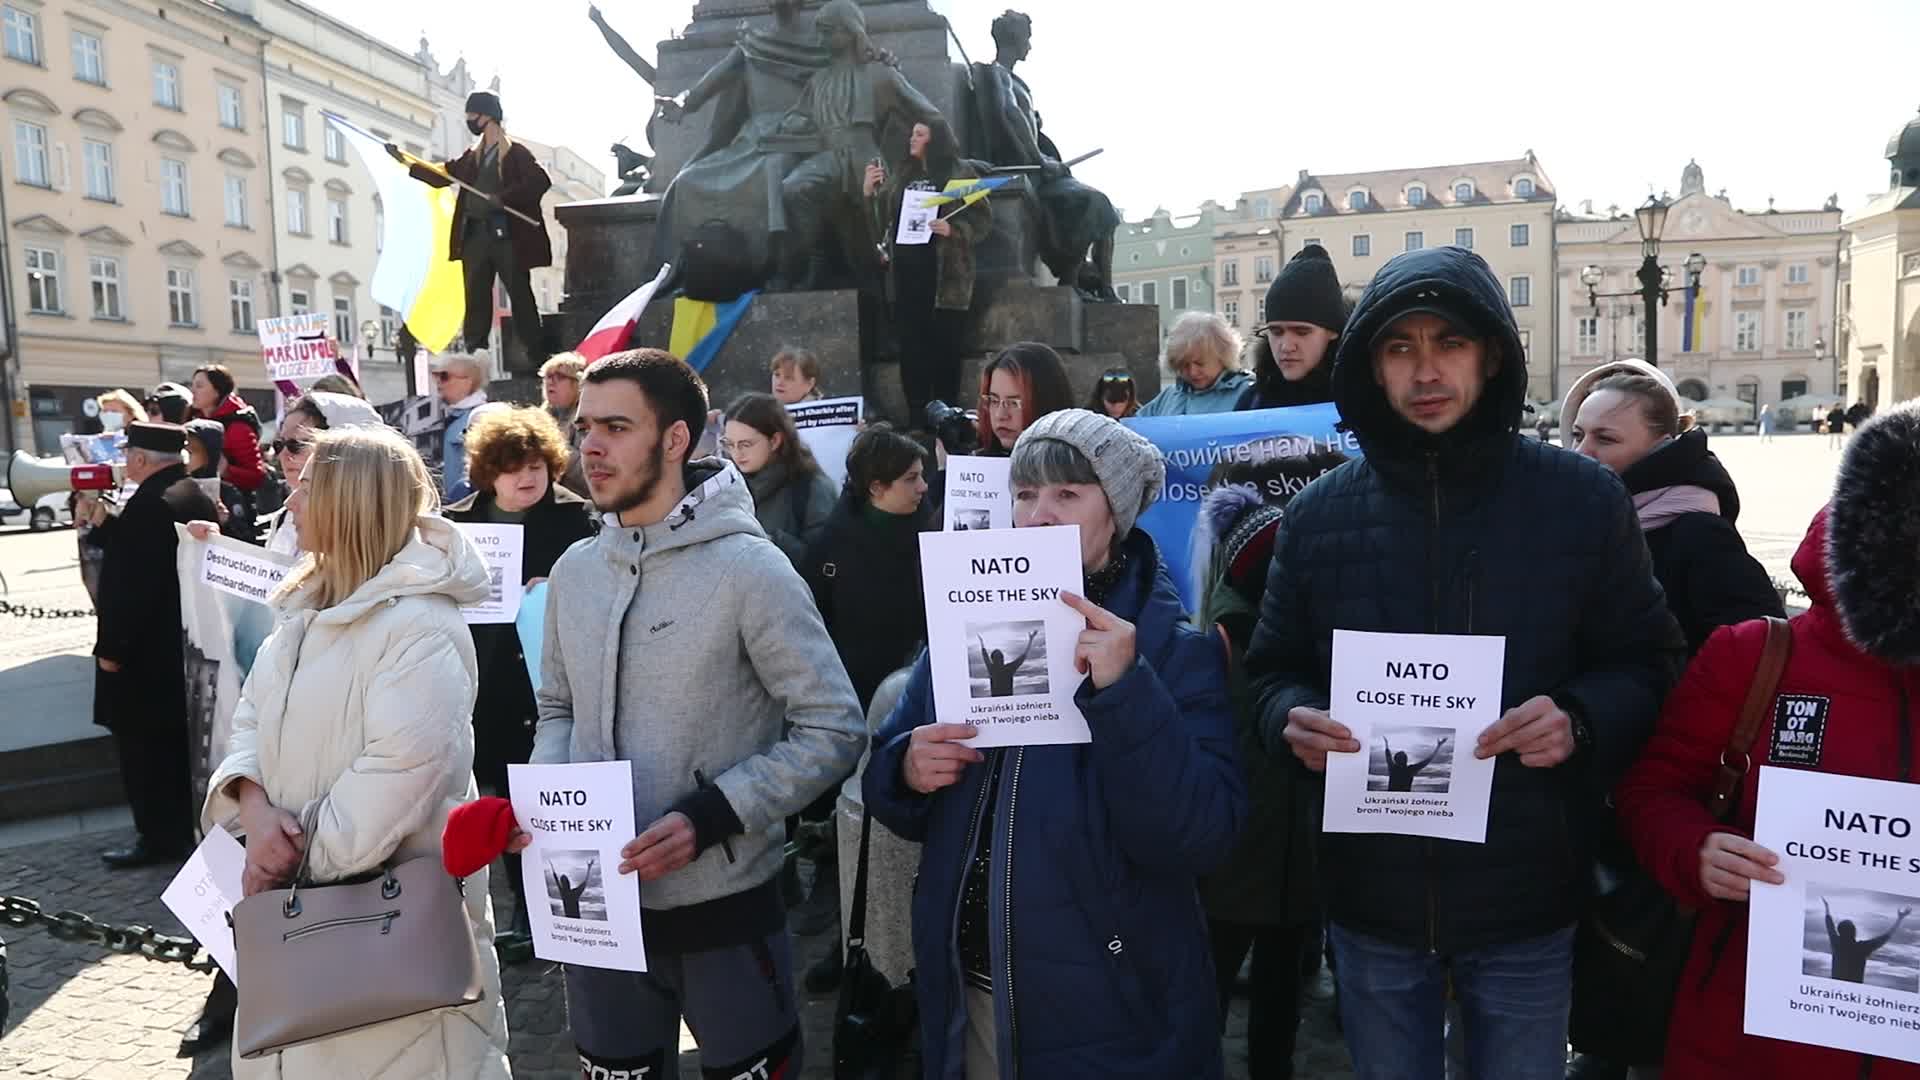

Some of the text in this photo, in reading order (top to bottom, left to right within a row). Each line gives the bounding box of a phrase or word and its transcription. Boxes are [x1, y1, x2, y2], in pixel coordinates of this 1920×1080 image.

[265, 341, 335, 364] MARIUPOL
[805, 406, 835, 416] Kharkiv
[835, 405, 856, 413] after
[808, 419, 817, 427] by
[818, 416, 853, 425] russians
[1163, 430, 1361, 473] крийте нам не
[960, 472, 985, 483] NATO
[968, 490, 982, 499] THE
[984, 491, 1000, 500] SKY
[474, 536, 500, 546] NATO
[207, 550, 257, 575] Destruction
[257, 564, 268, 578] in
[971, 556, 1030, 575] NATO
[206, 569, 267, 598] bombardment
[948, 587, 1060, 604] CLOSE THE SKY
[1386, 661, 1449, 681] NATO
[1356, 690, 1476, 710] CLOSE THE SKY
[992, 714, 1031, 725] Twojego
[1033, 712, 1060, 721] nieba
[539, 789, 587, 807] NATO
[1356, 806, 1454, 818] broni Twojego nieba
[530, 817, 613, 832] CLOSE THE SKY
[1824, 808, 1911, 838] NATO
[1785, 840, 1851, 864] CLOSE
[1858, 850, 1901, 871] THE
[568, 935, 597, 947] Twojego
[598, 939, 618, 948] nieba
[1800, 984, 1920, 1014] Ukraiński żołnierz
[1789, 999, 1920, 1031] broni Twojego nieb
